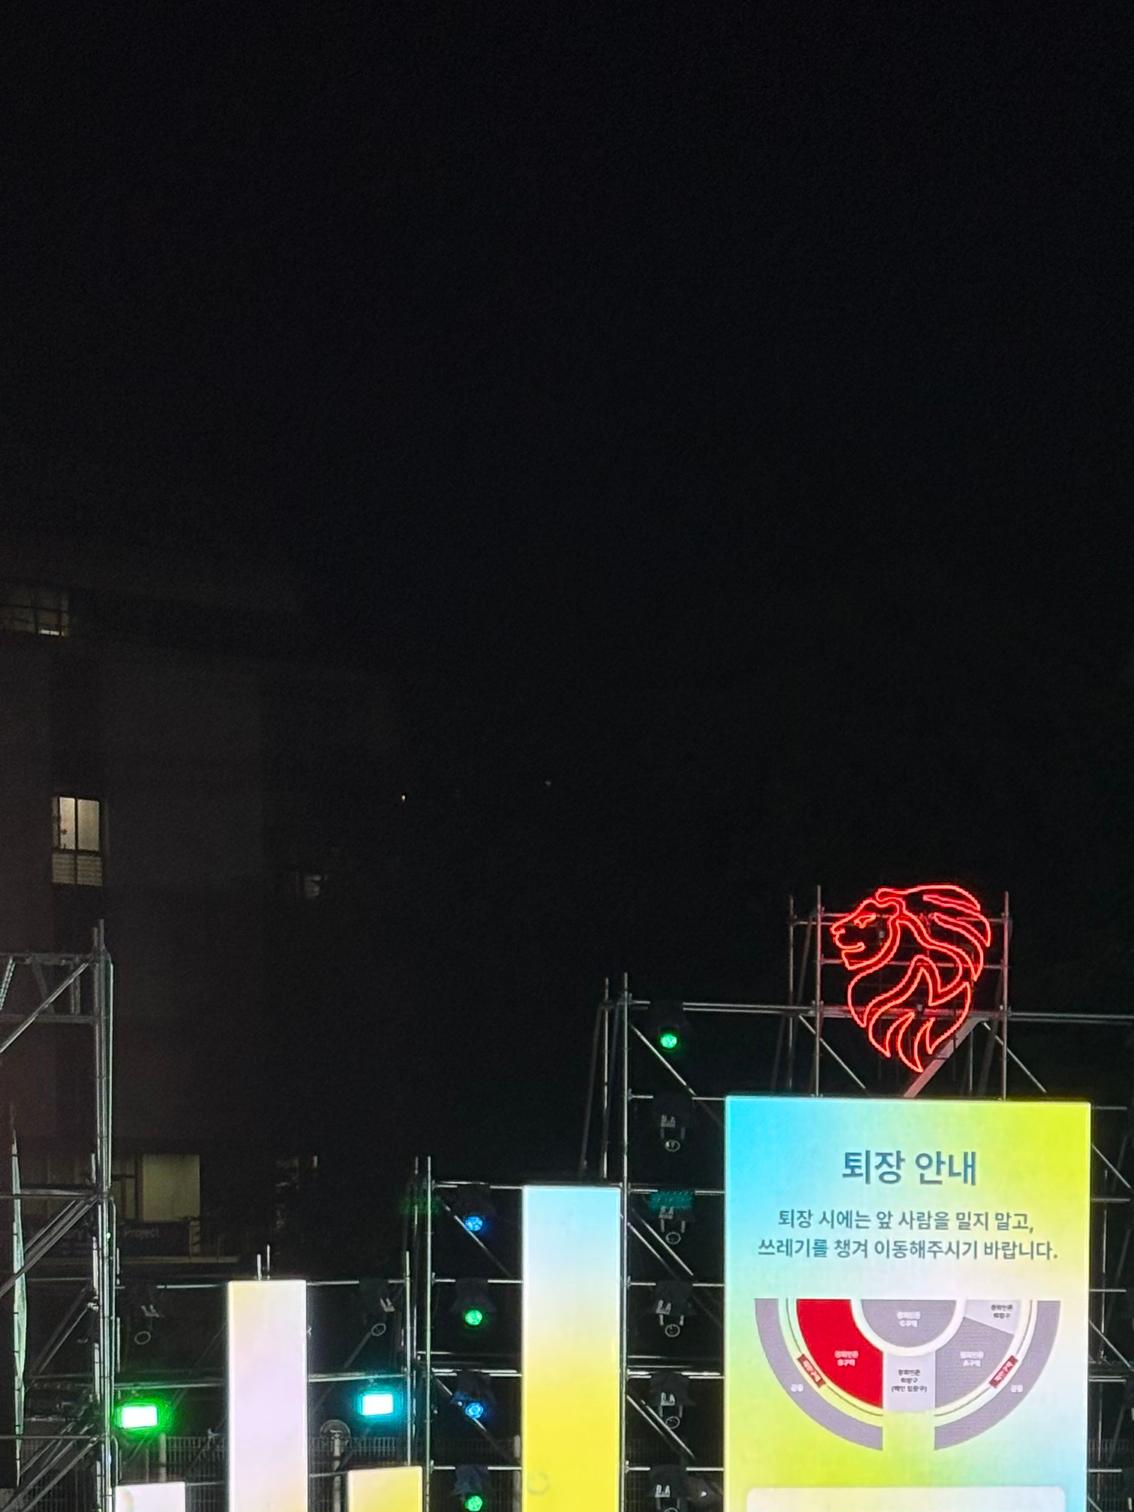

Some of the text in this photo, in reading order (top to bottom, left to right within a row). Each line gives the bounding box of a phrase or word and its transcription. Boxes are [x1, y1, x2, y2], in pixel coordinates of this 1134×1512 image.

[842, 1150, 976, 1186] 퇴장 안내
[779, 1209, 1033, 1233] 퇴장 시에는 앞 사람을 밀지 말고,
[758, 1239, 1057, 1260] 쓰레기를 챙겨 이동해주시기 바랍니다.
